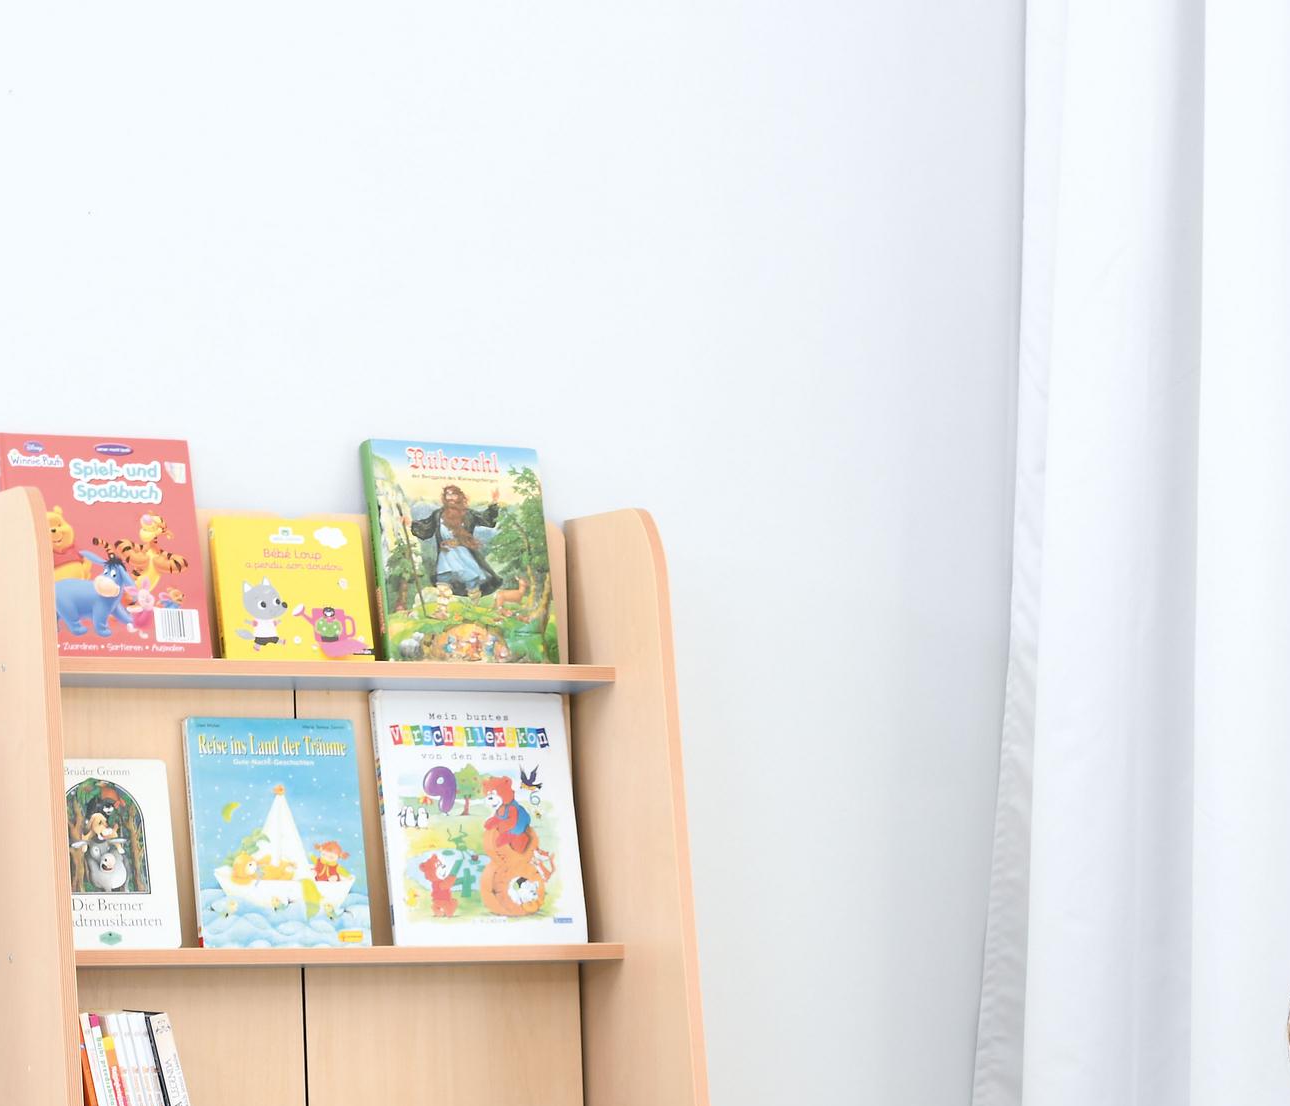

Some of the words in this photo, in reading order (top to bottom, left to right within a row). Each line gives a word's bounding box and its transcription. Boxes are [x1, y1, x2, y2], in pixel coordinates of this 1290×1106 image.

[406, 446, 500, 474] Rübezahl
[72, 462, 121, 479] Spiel-
[126, 464, 158, 478] und
[77, 484, 159, 501] Spaßbuch
[428, 711, 458, 721] Mein
[466, 712, 509, 722] buntes
[198, 734, 229, 757] Reise
[230, 734, 248, 757] ins
[249, 734, 280, 757] Land
[281, 735, 301, 757] der
[302, 735, 347, 758] Träume
[420, 753, 443, 761] von
[450, 751, 473, 761] den
[481, 751, 525, 761] Zahlen
[97, 765, 131, 776] Grimm
[71, 897, 95, 912] Die
[97, 897, 144, 912] Bremer
